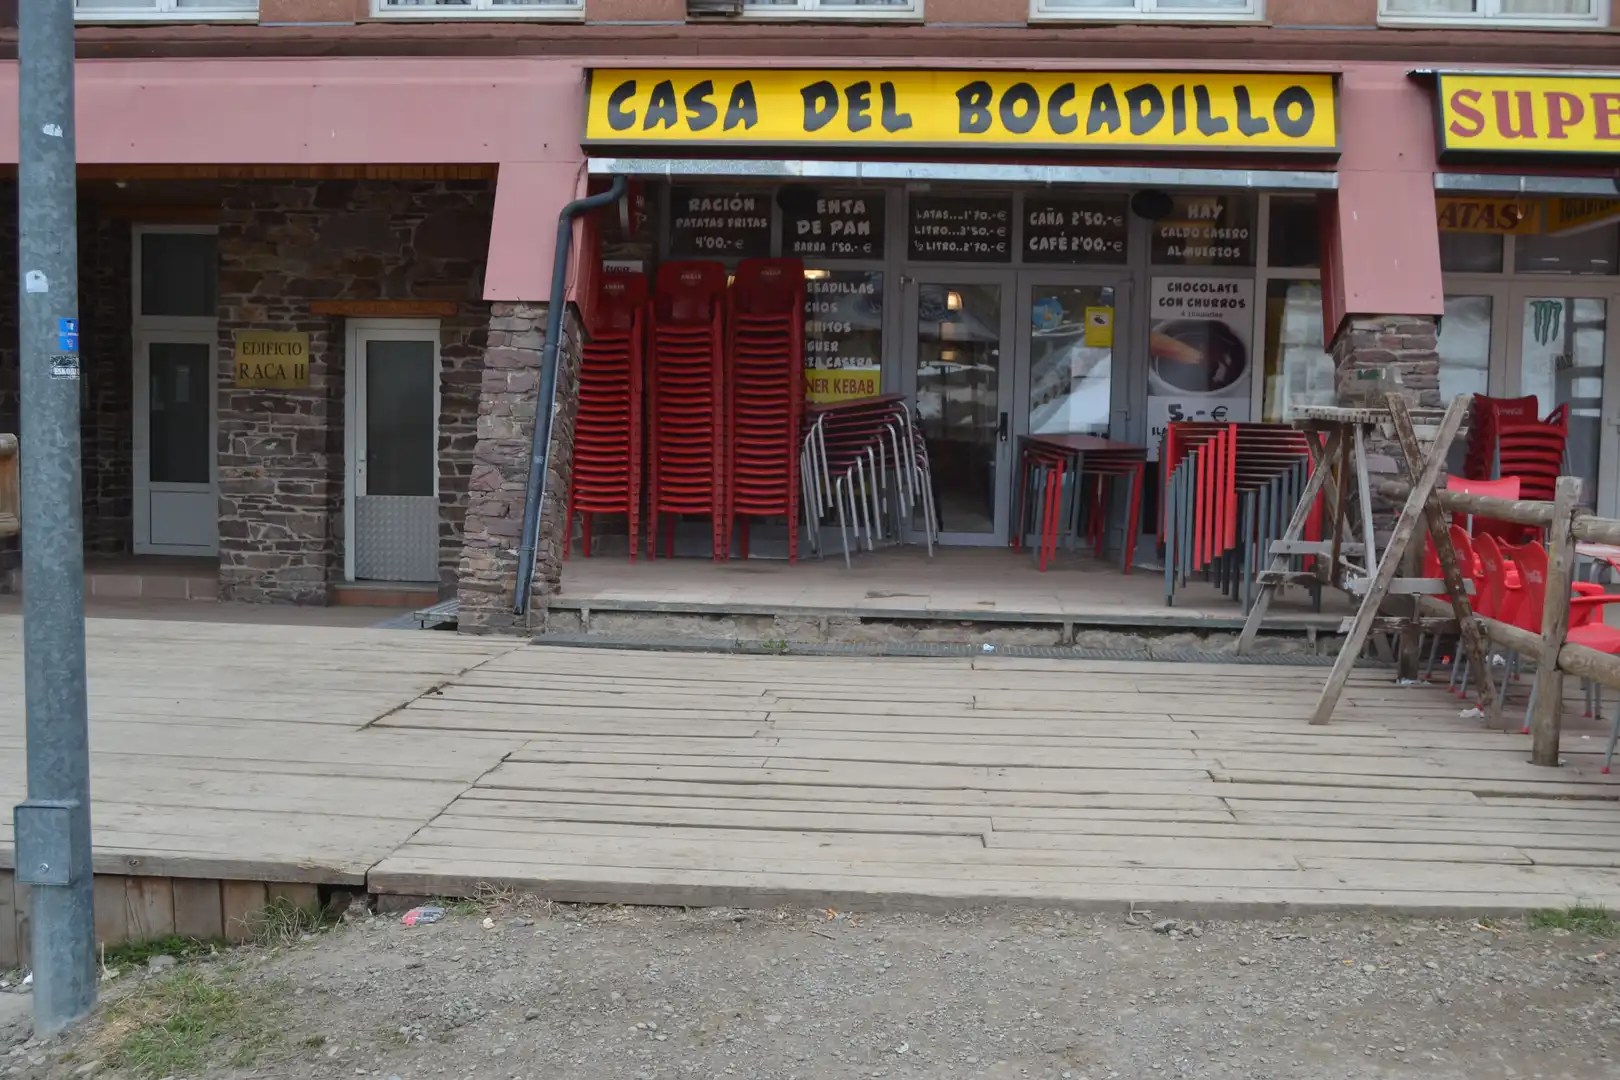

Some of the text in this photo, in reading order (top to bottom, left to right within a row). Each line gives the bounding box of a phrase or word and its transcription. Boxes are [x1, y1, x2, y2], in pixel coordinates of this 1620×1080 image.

[608, 79, 1315, 138] CASA DEL BOCADILLO
[1449, 88, 1620, 140] SUPE
[688, 192, 755, 212] RACIÓN
[816, 199, 866, 214] ENTA
[1030, 207, 1064, 226] CAÑA
[1187, 203, 1224, 220] HAY
[676, 217, 768, 228] PATATAS FRITAS
[796, 220, 870, 236] DE PAN
[1160, 227, 1249, 239] CALDO CASERO
[794, 241, 826, 252] BARRA
[1029, 231, 1068, 251] CAFÉ
[1167, 245, 1241, 258] ALMUERZOS
[807, 282, 874, 294] ESADILLAS
[1167, 282, 1239, 293] CHOCOLATE
[804, 301, 838, 313] CHOS
[1158, 297, 1246, 309] CON CHURROS
[242, 341, 302, 355] EDIFICIO
[807, 340, 839, 352] GUER
[826, 356, 873, 368] CASERA
[239, 362, 305, 380] RACA II
[805, 378, 875, 395] NER KEBAB
